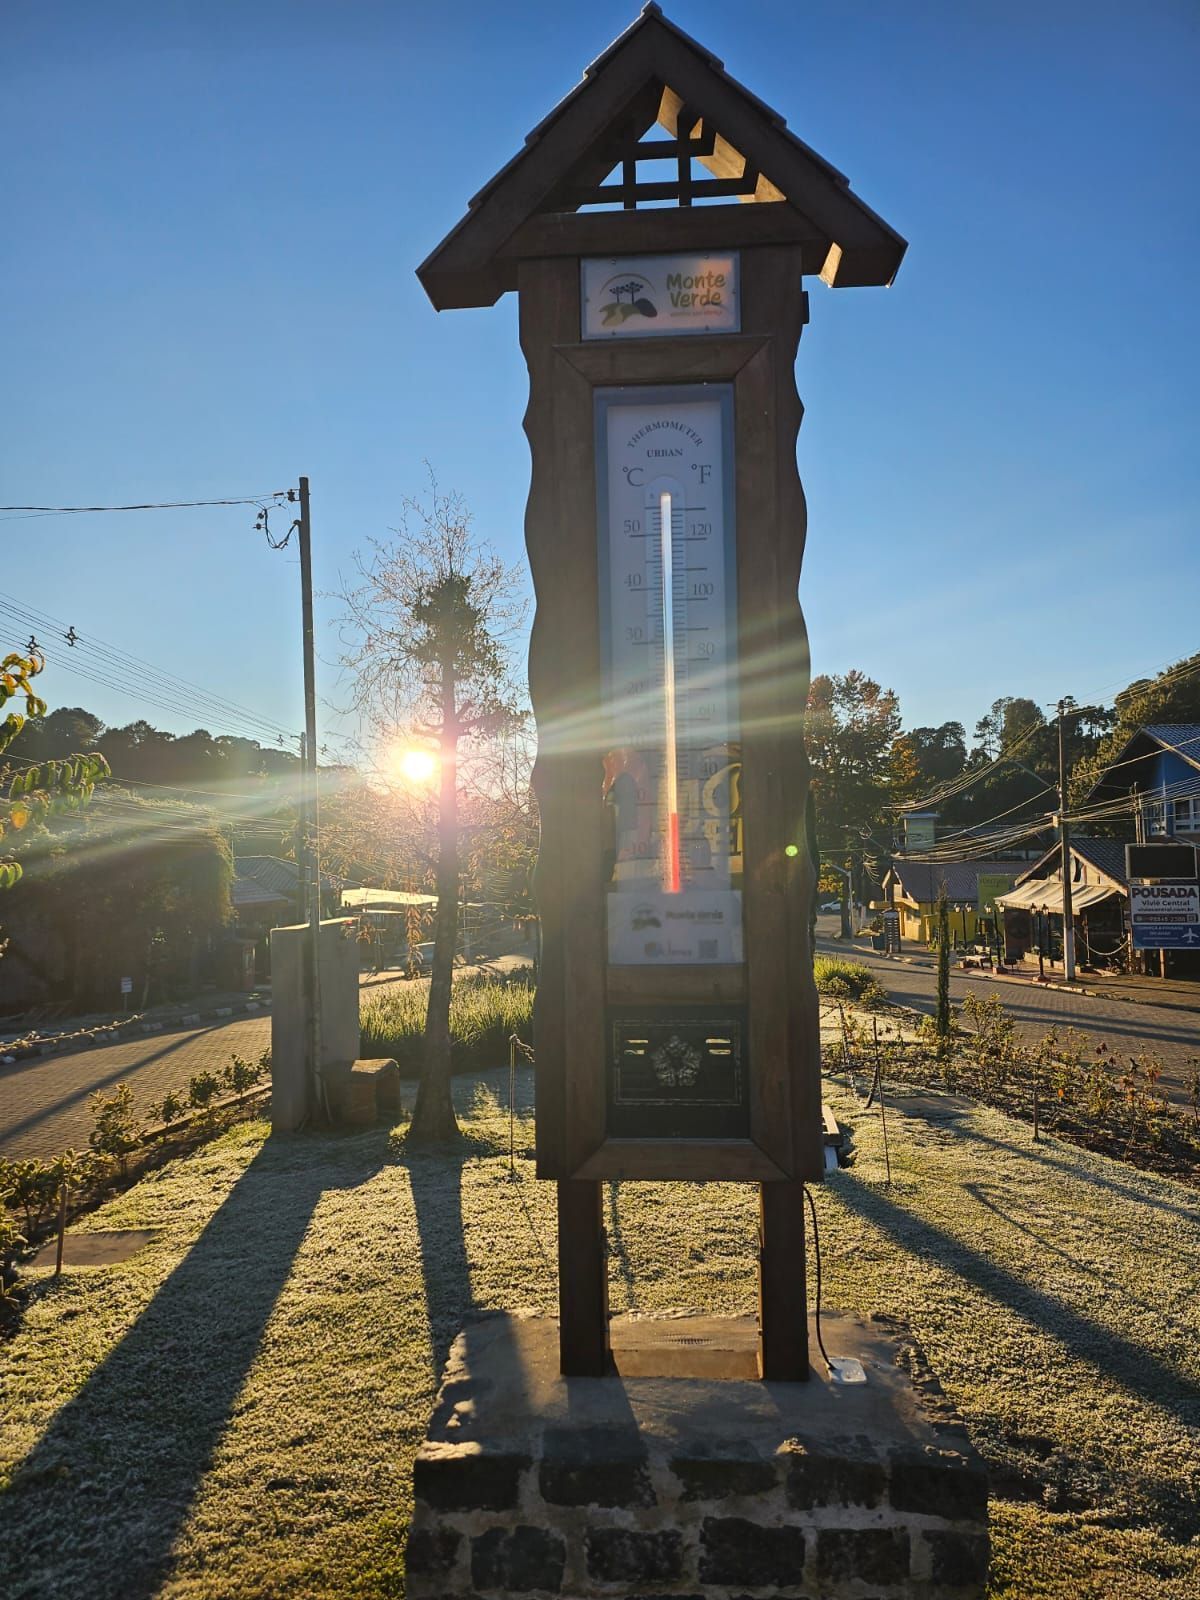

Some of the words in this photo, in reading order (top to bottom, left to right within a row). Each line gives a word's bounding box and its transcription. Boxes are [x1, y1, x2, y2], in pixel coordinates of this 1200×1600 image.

[666, 271, 726, 291] Monte
[670, 287, 722, 308] Verde
[627, 420, 703, 449] THERMOMETER
[646, 448, 684, 458] URBAN
[623, 519, 641, 534] 50
[691, 523, 712, 536] 120
[624, 573, 642, 587] 40
[692, 583, 714, 596] 100
[1132, 888, 1197, 898] POUSADA
